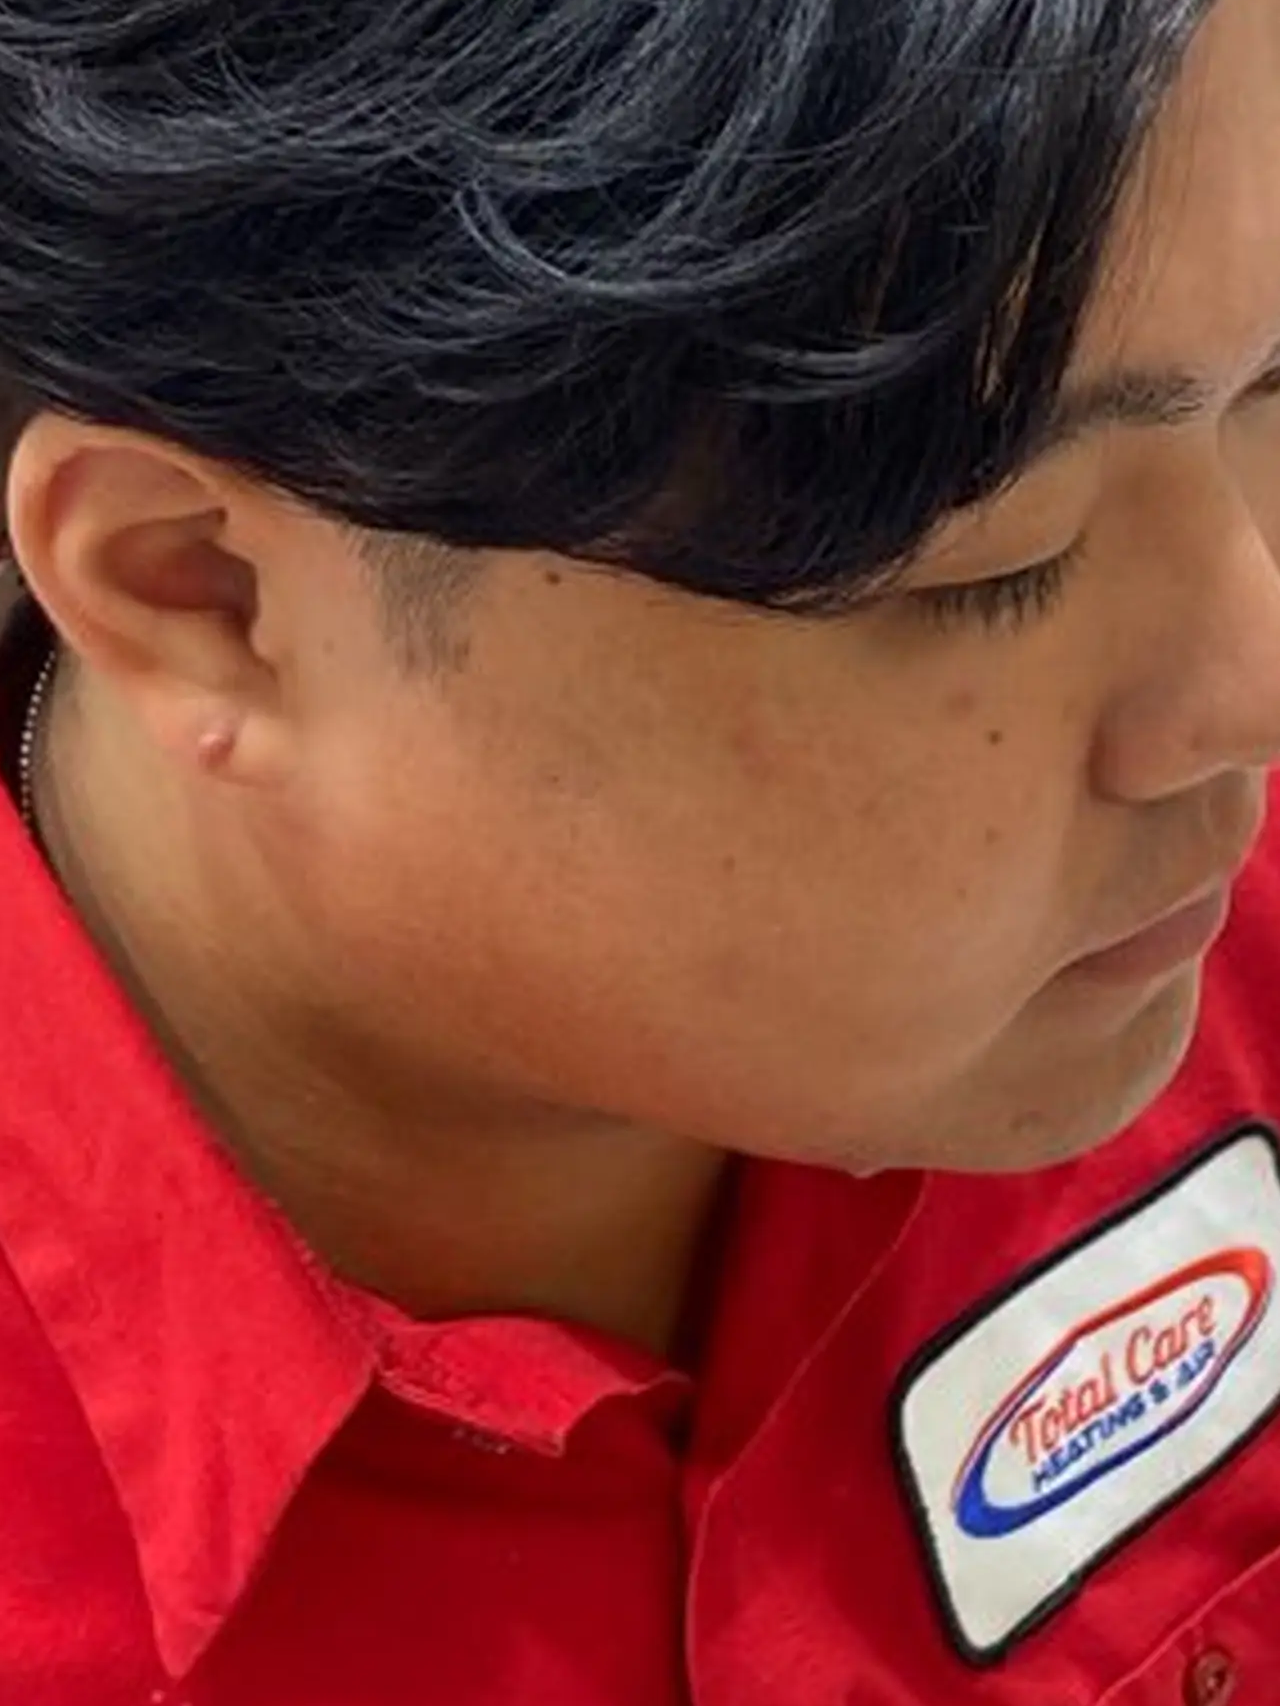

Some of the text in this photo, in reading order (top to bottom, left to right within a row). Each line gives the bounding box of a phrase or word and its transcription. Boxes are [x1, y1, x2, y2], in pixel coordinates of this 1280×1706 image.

[1008, 1295, 1216, 1464] Total Care
[1033, 1391, 1146, 1492] HEATING
[1176, 1339, 1215, 1388] AIR
